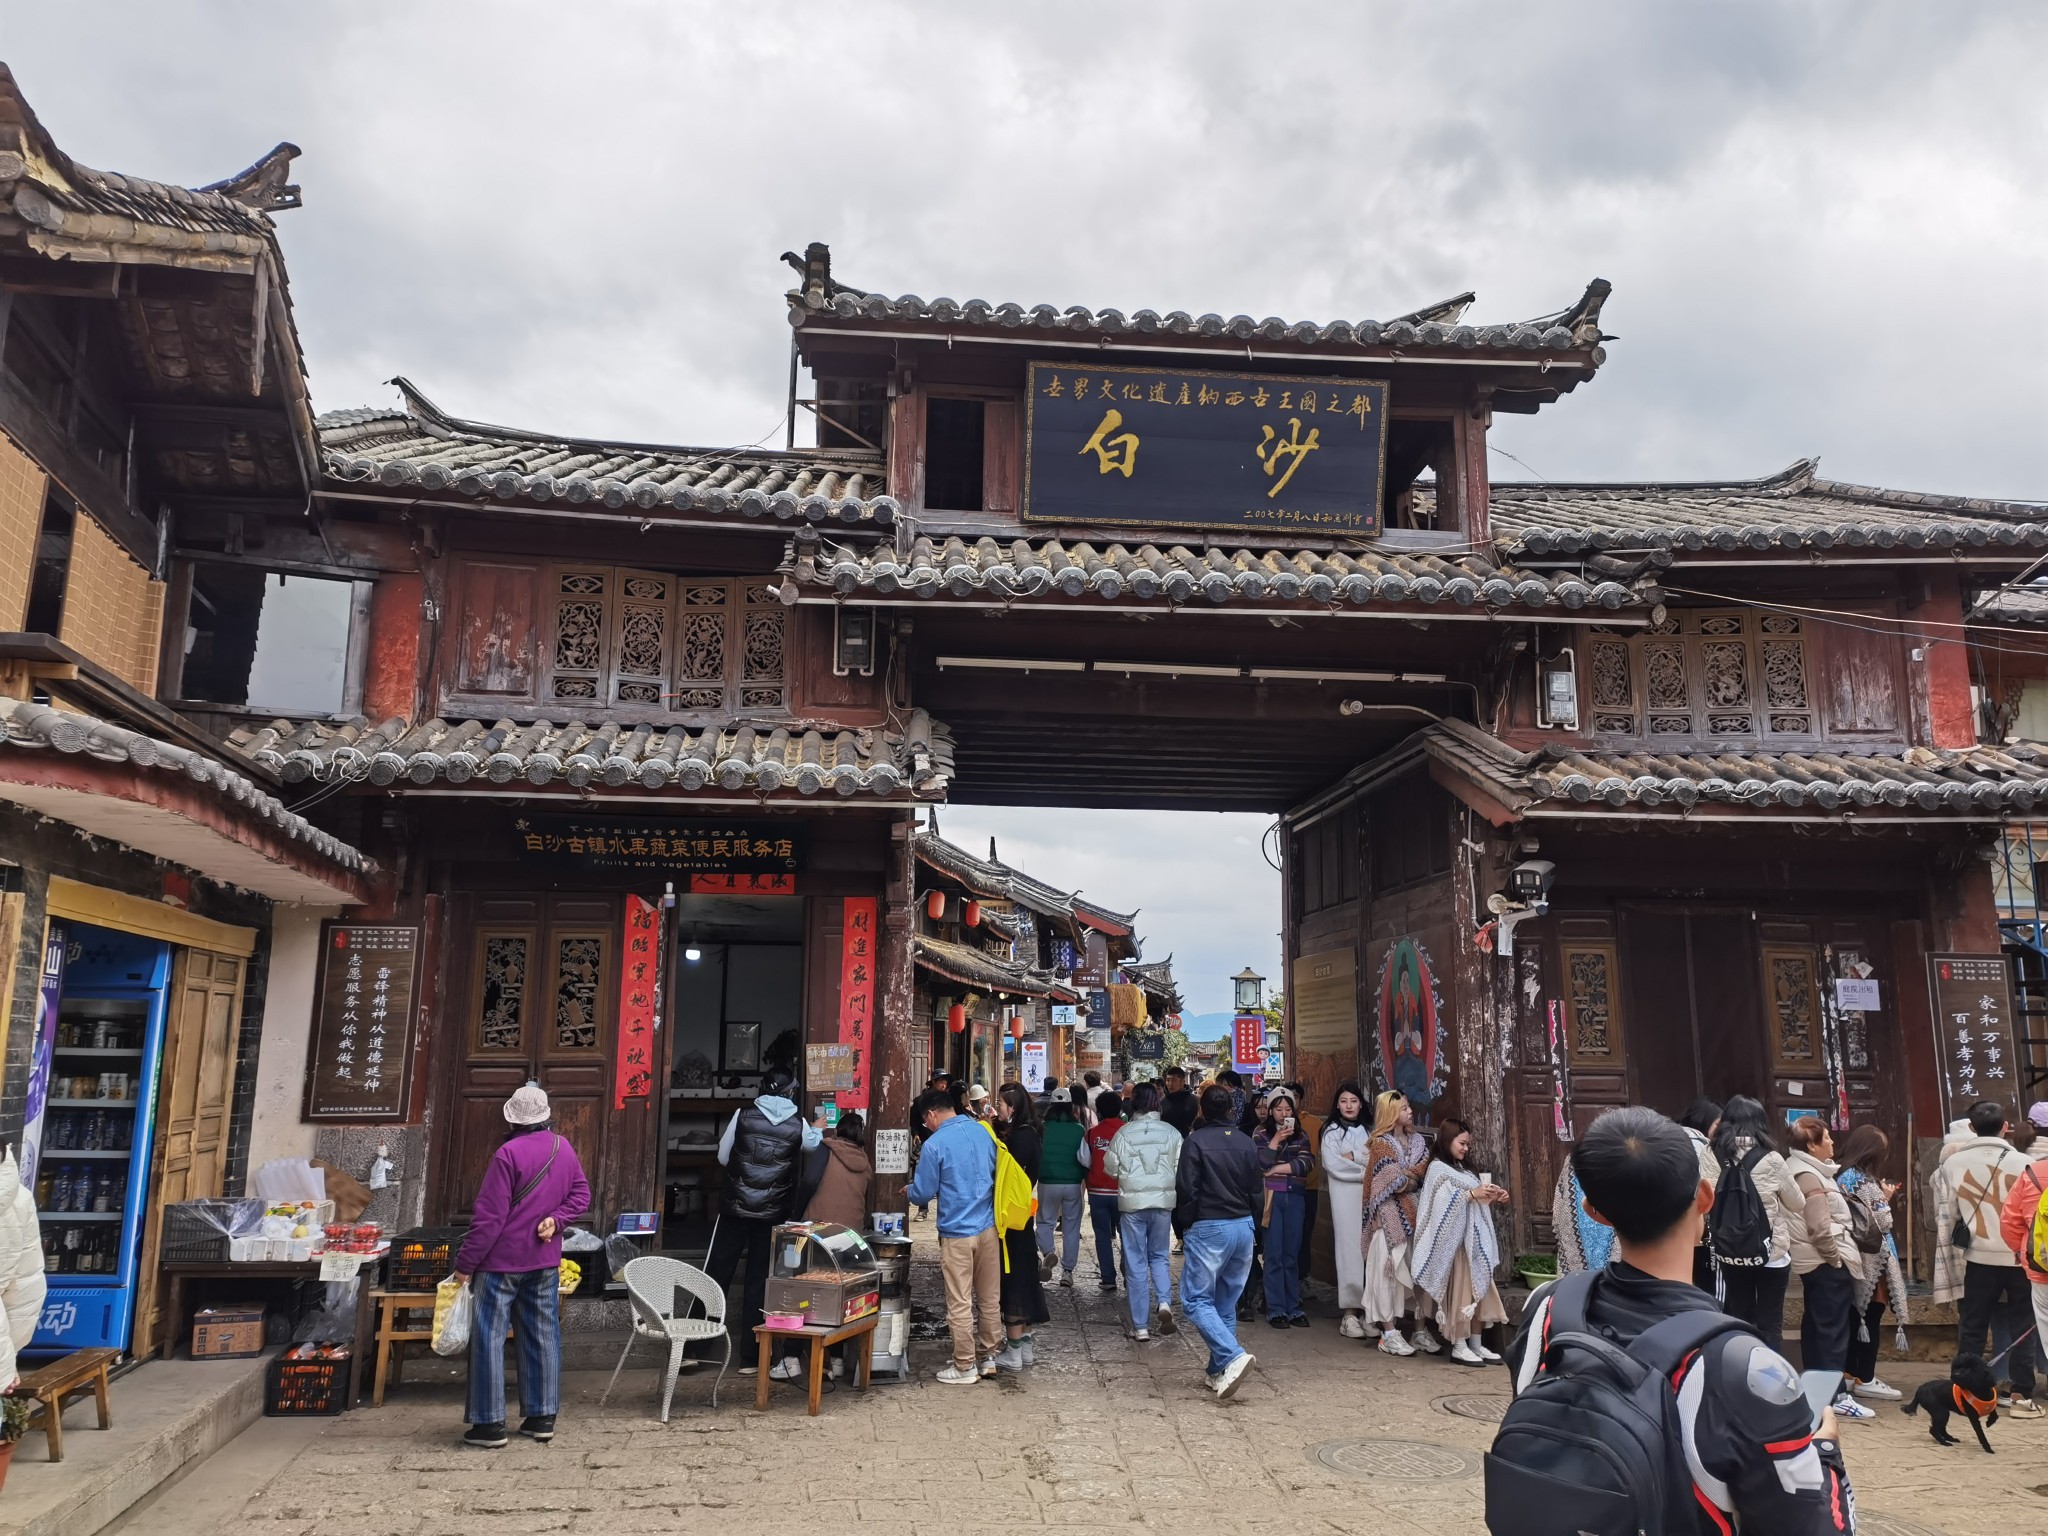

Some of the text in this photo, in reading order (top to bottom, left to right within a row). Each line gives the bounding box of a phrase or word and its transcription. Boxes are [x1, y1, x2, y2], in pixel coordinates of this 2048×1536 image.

[524, 832, 793, 858] 白沙古镇水果蔬菜便民服务店
[593, 858, 629, 866] Fruits
[334, 953, 363, 1079] 志愿服务从你我做起
[363, 967, 391, 1093] 雷锋精神从道德延伸
[1952, 1013, 1979, 1097] 百善孝为先
[1979, 995, 2005, 1079] 家和万事兴
